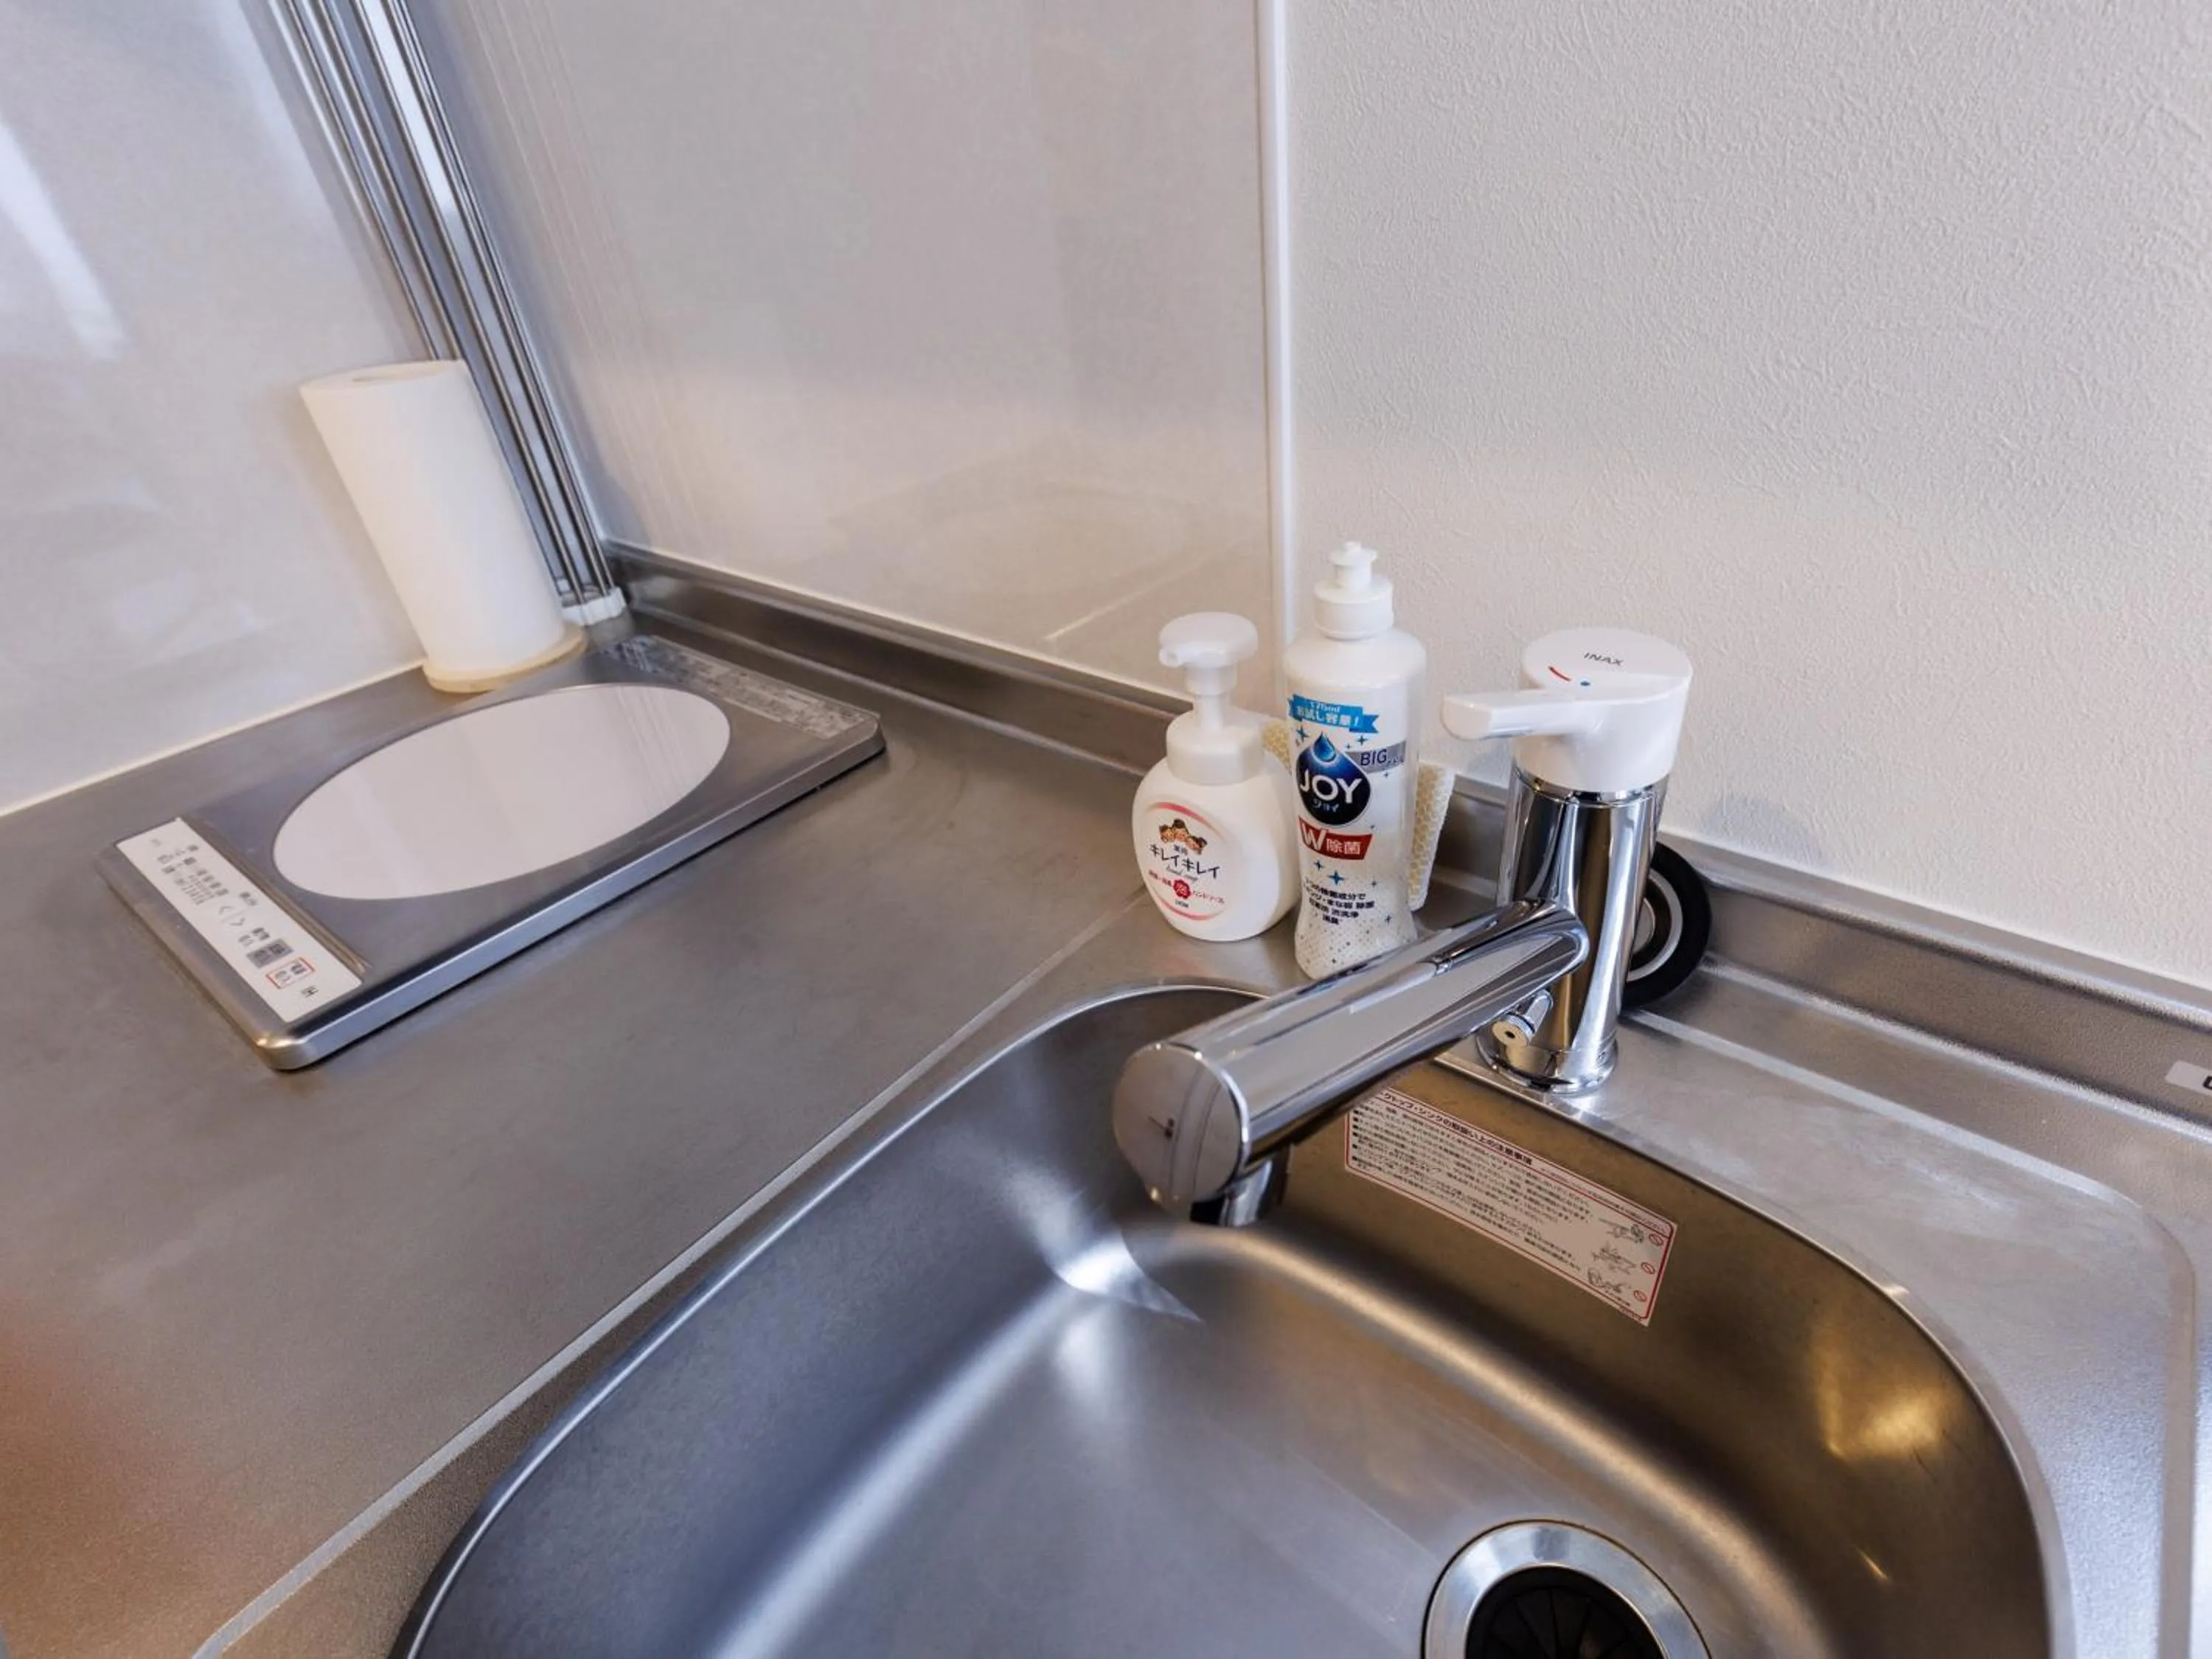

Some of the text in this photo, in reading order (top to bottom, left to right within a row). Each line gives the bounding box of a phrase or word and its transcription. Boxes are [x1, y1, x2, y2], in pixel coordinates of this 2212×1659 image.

[1583, 652, 1624, 667] INAX
[1360, 748, 1387, 766] BIG
[1300, 768, 1363, 804] JOY
[1150, 844, 1220, 880] キレイキレイ
